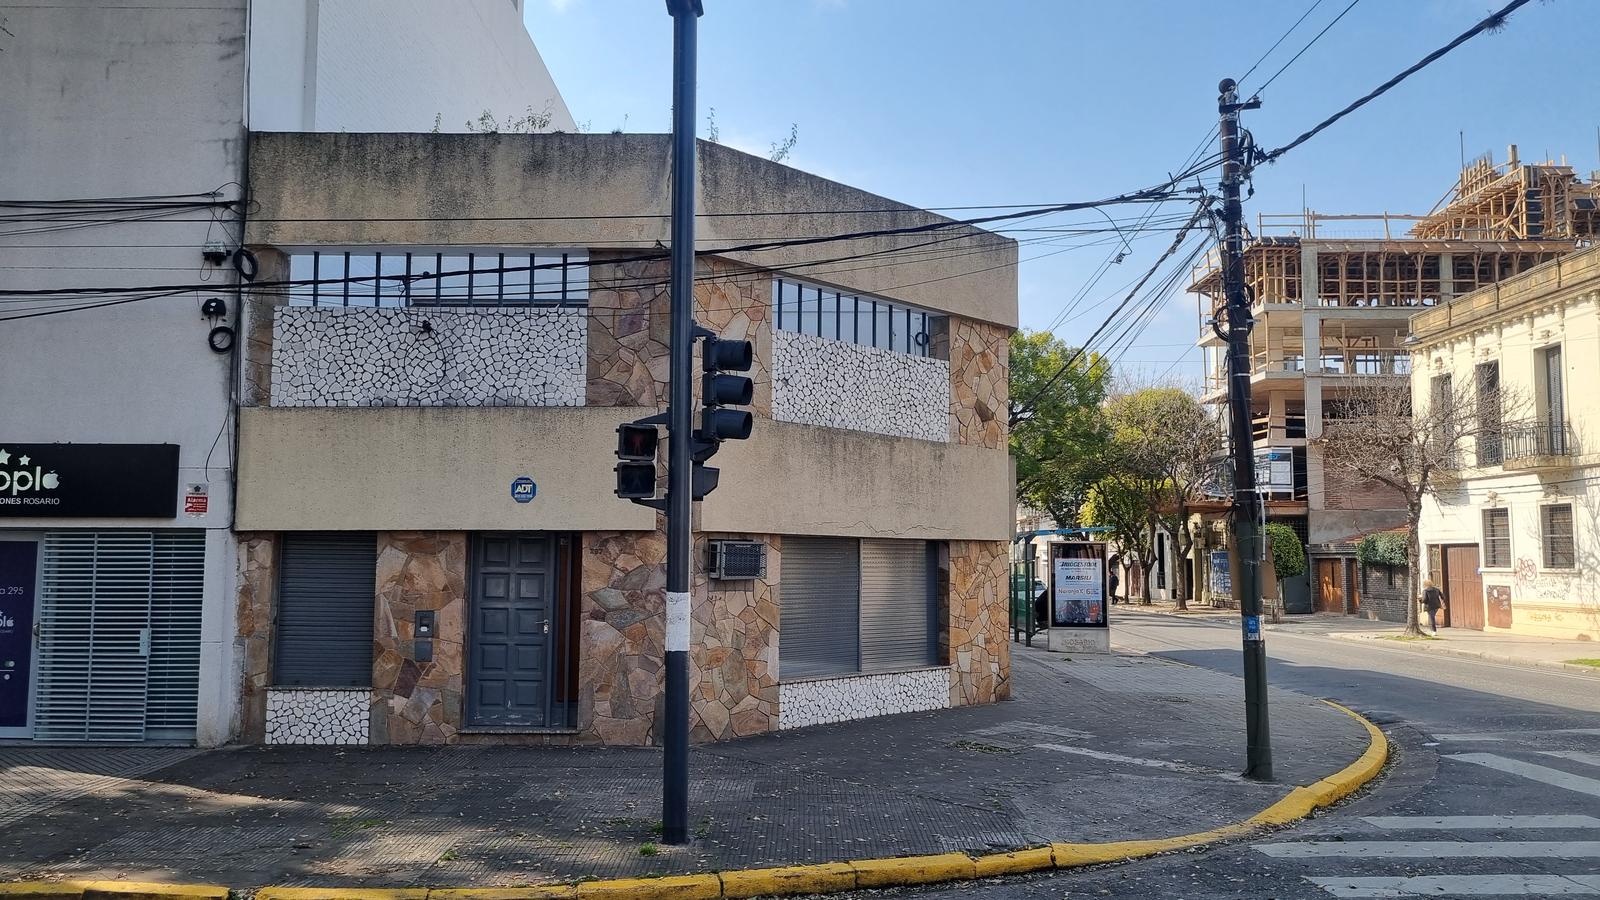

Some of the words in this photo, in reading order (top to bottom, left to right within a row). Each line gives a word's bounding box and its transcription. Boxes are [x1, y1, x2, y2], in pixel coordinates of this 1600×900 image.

[515, 484, 533, 494] ADT
[23, 497, 60, 505] ROSARIO
[8, 586, 24, 595] 295
